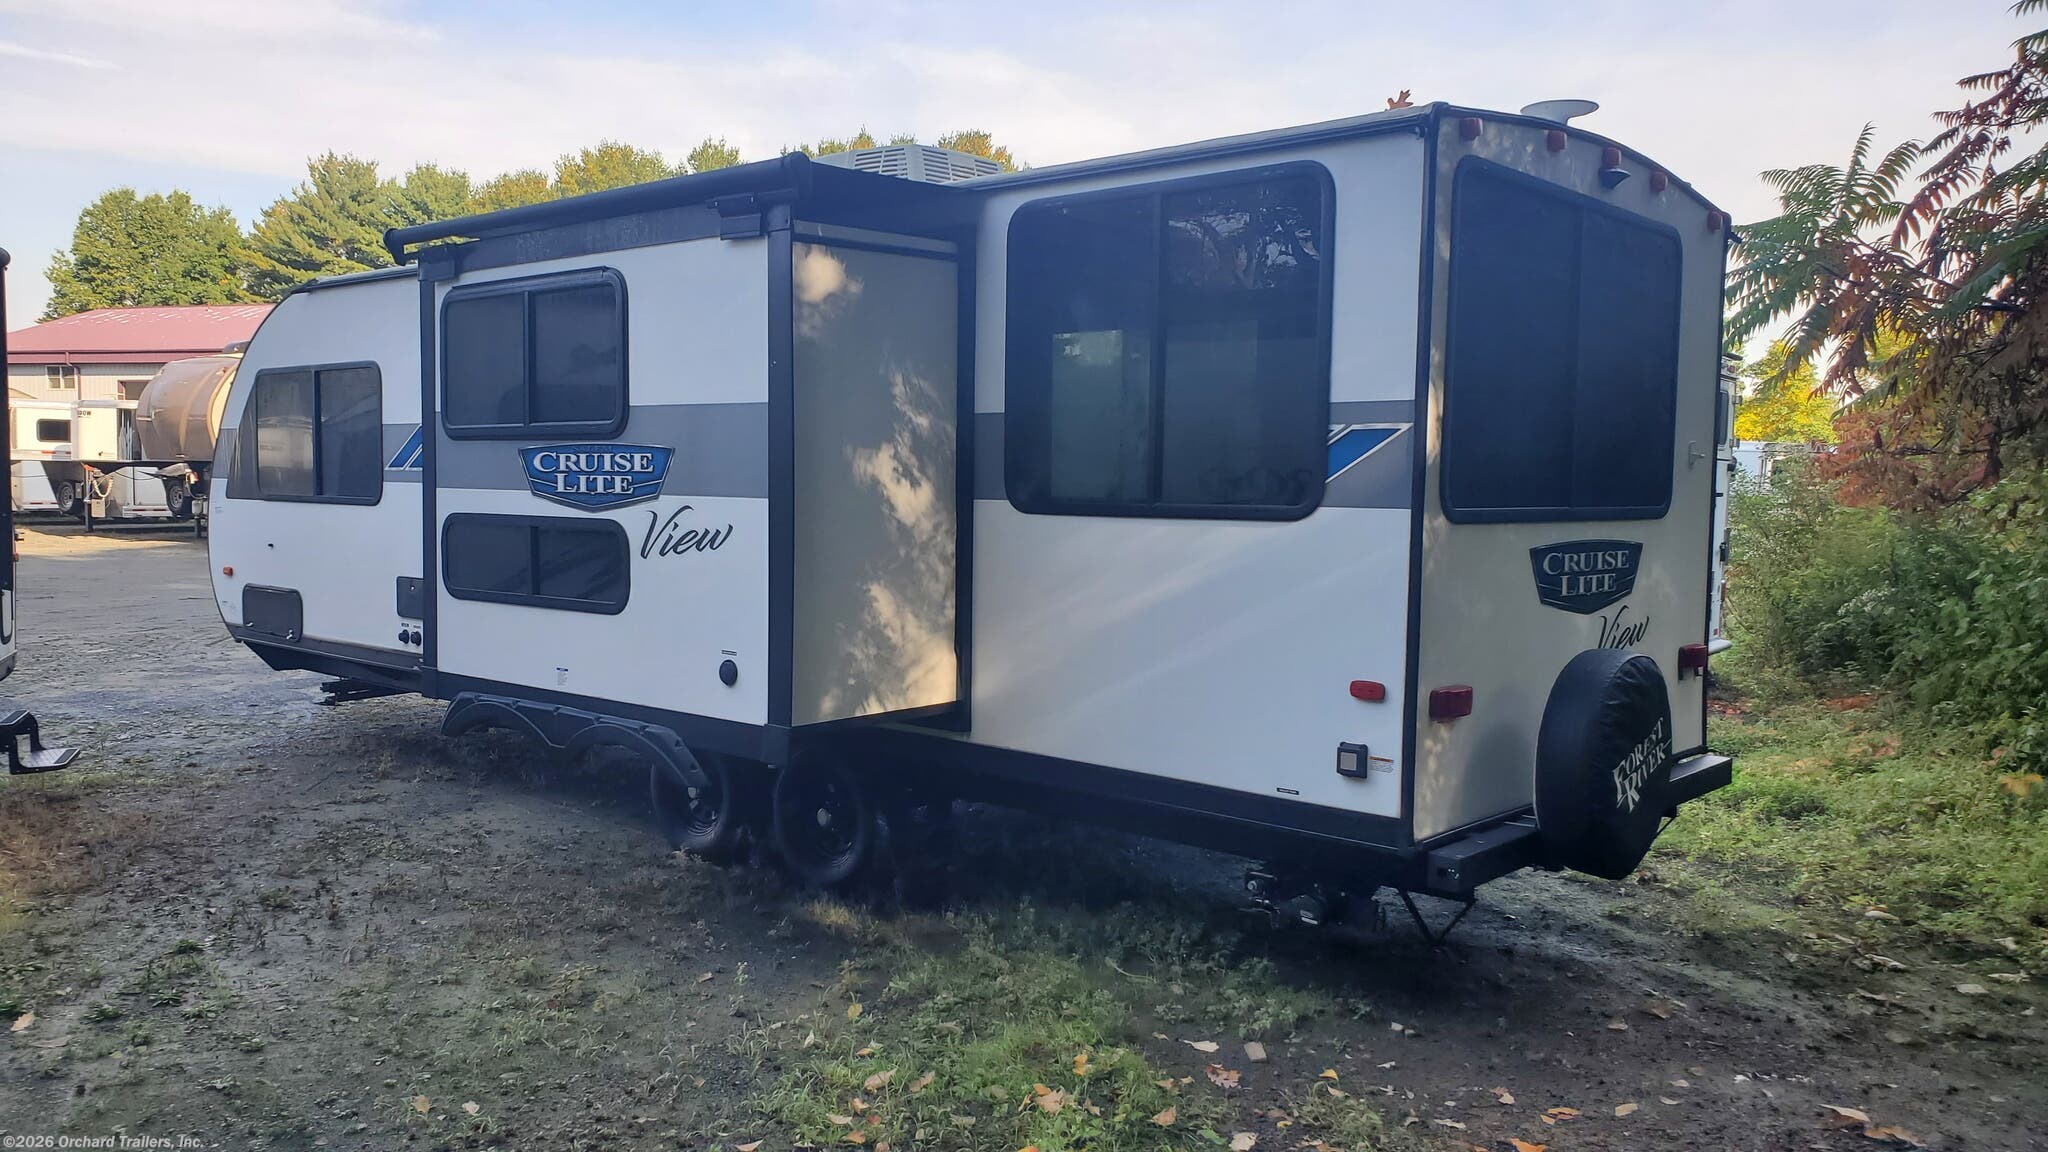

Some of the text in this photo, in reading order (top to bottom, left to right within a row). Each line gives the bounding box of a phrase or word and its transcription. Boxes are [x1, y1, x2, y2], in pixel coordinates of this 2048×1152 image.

[533, 452, 654, 473] CRUISE
[555, 473, 634, 495] LITE
[640, 505, 734, 560] View
[1542, 549, 1630, 576] CRUISE
[1560, 572, 1617, 597] LITE
[1597, 605, 1649, 650] View
[1612, 716, 1664, 802] FOREST
[1617, 744, 1668, 813] RIVER
